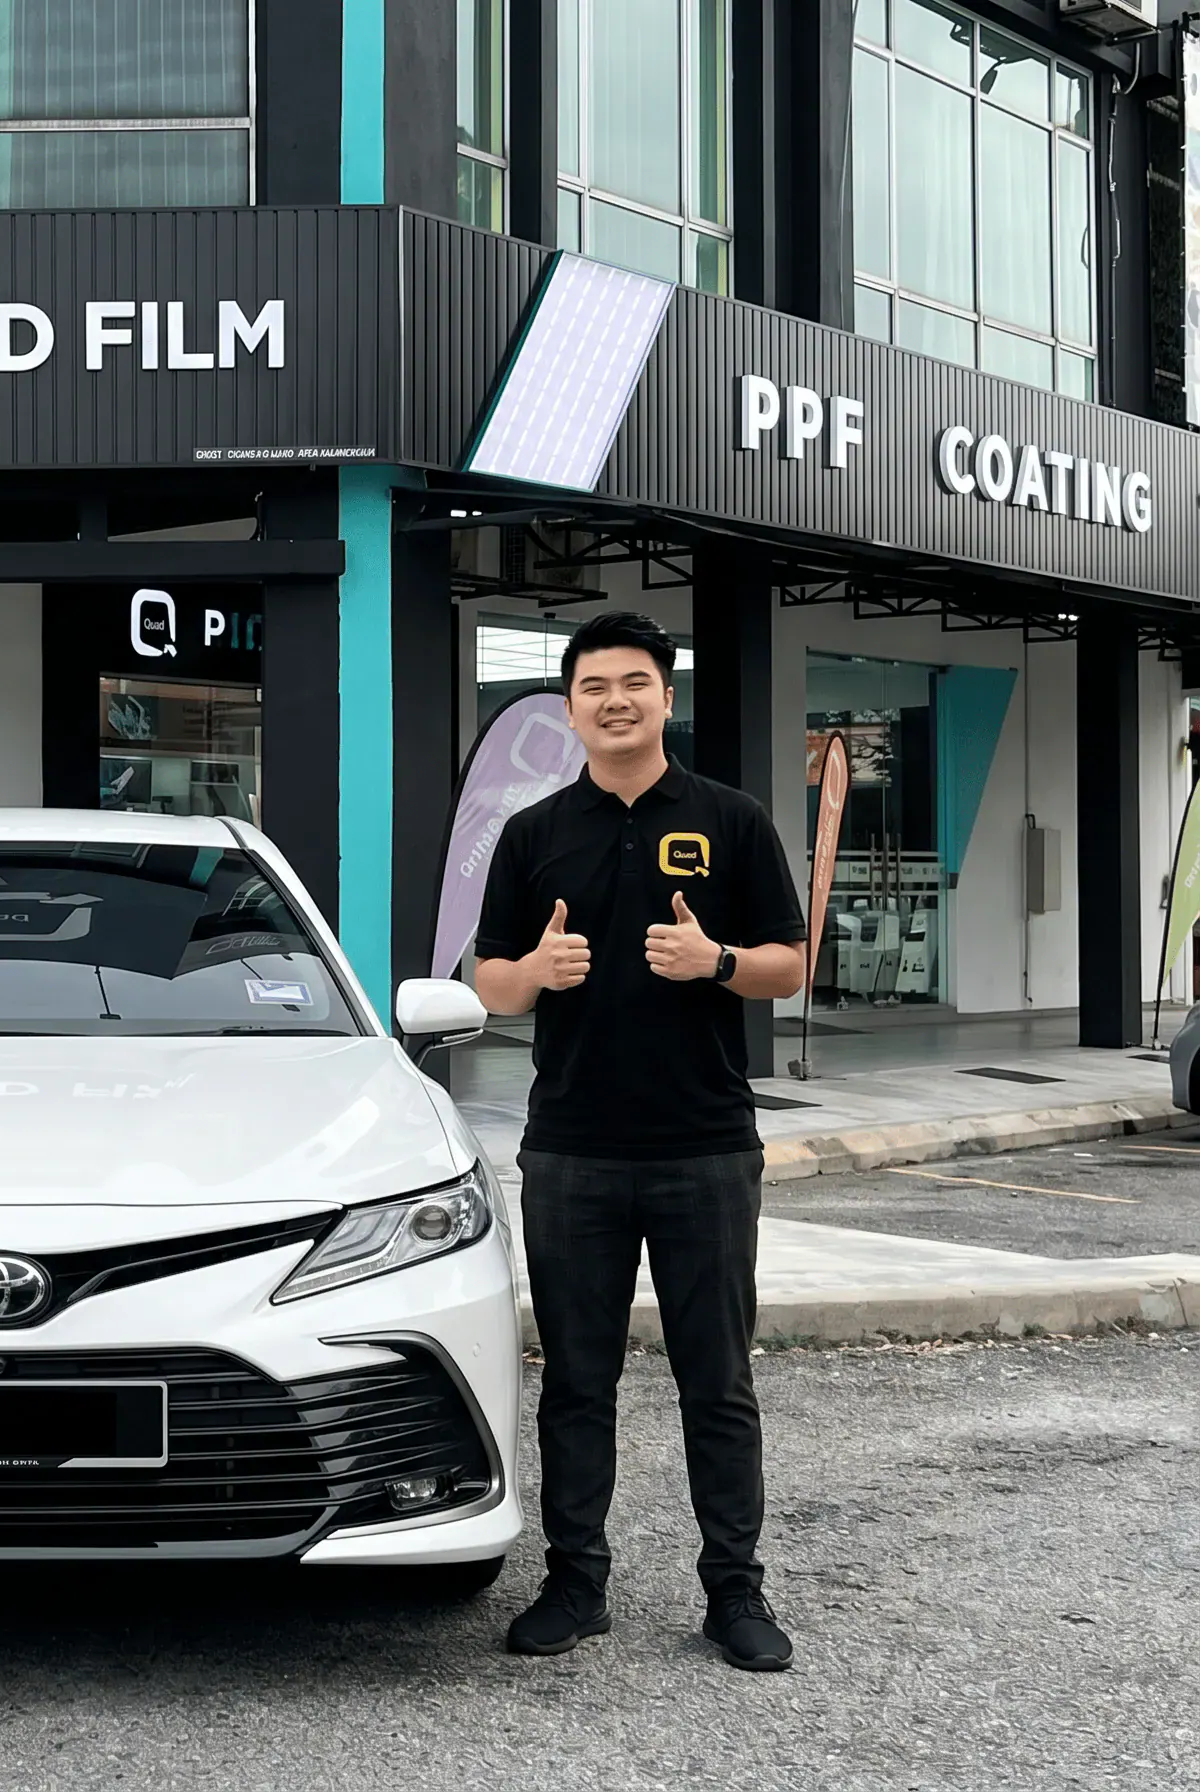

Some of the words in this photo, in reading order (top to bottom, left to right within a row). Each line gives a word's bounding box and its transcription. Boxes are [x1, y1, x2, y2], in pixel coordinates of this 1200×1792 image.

[85, 299, 285, 371] FILM
[740, 373, 865, 469] PPF
[939, 425, 1153, 533] COATING
[143, 618, 165, 632] Quad
